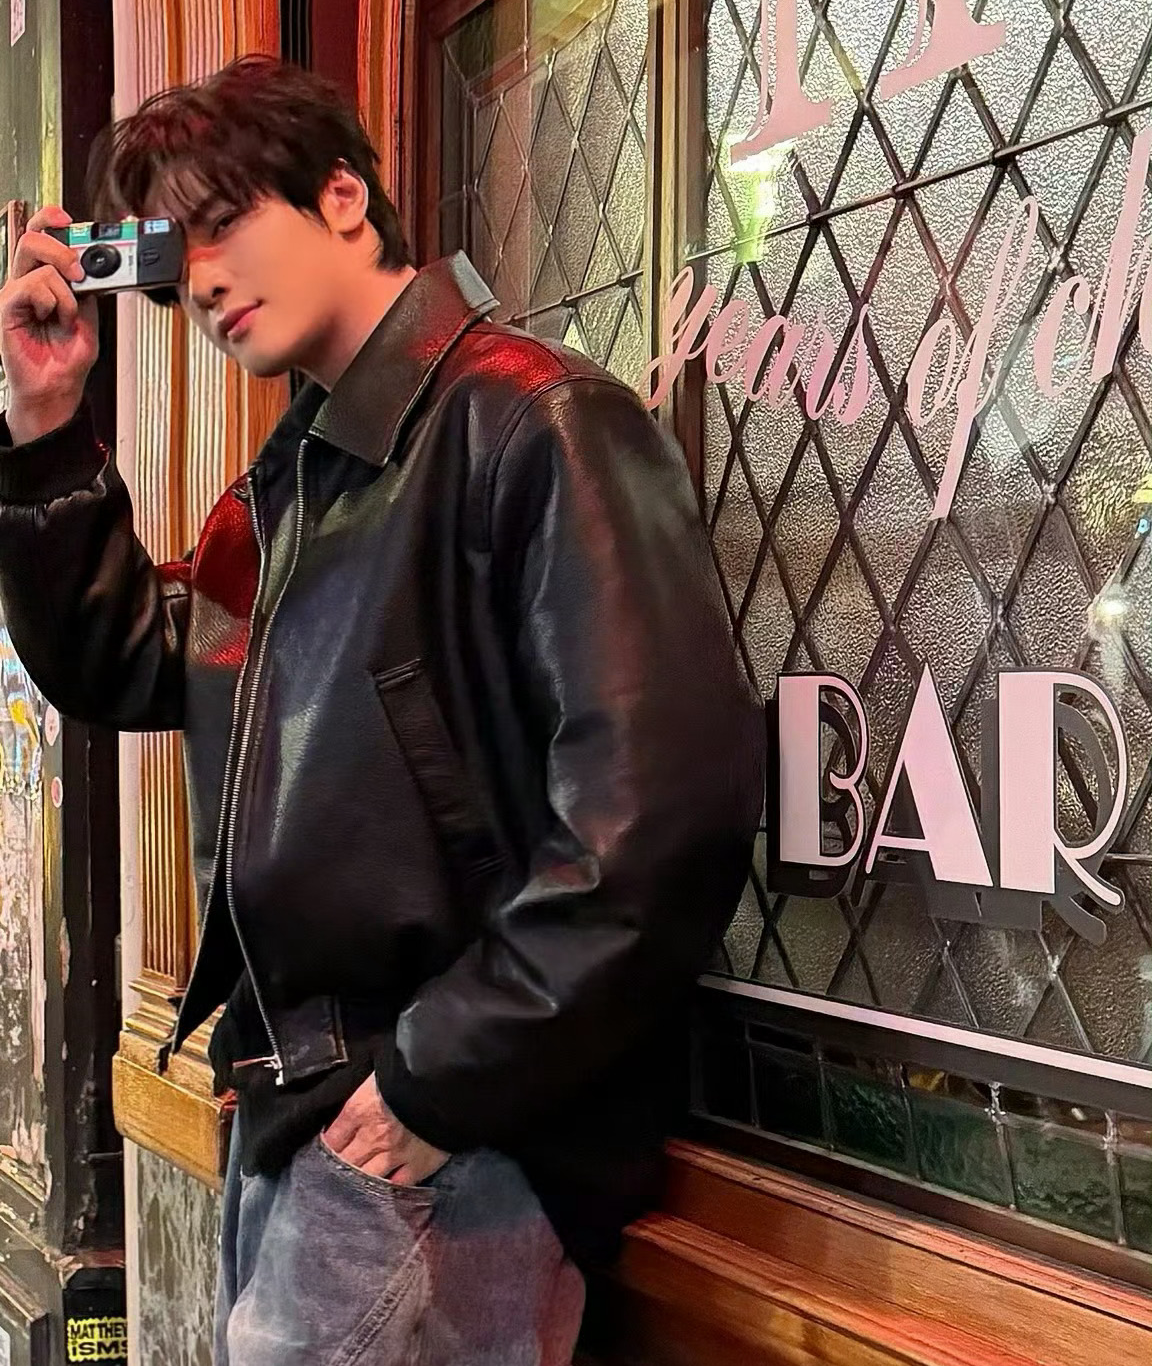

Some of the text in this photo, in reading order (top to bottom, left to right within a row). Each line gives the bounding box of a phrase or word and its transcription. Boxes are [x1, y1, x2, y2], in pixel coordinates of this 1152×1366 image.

[640, 265, 874, 427] years
[905, 195, 1039, 521] of
[778, 661, 1127, 907] BAR
[70, 1321, 128, 1340] MATTHE
